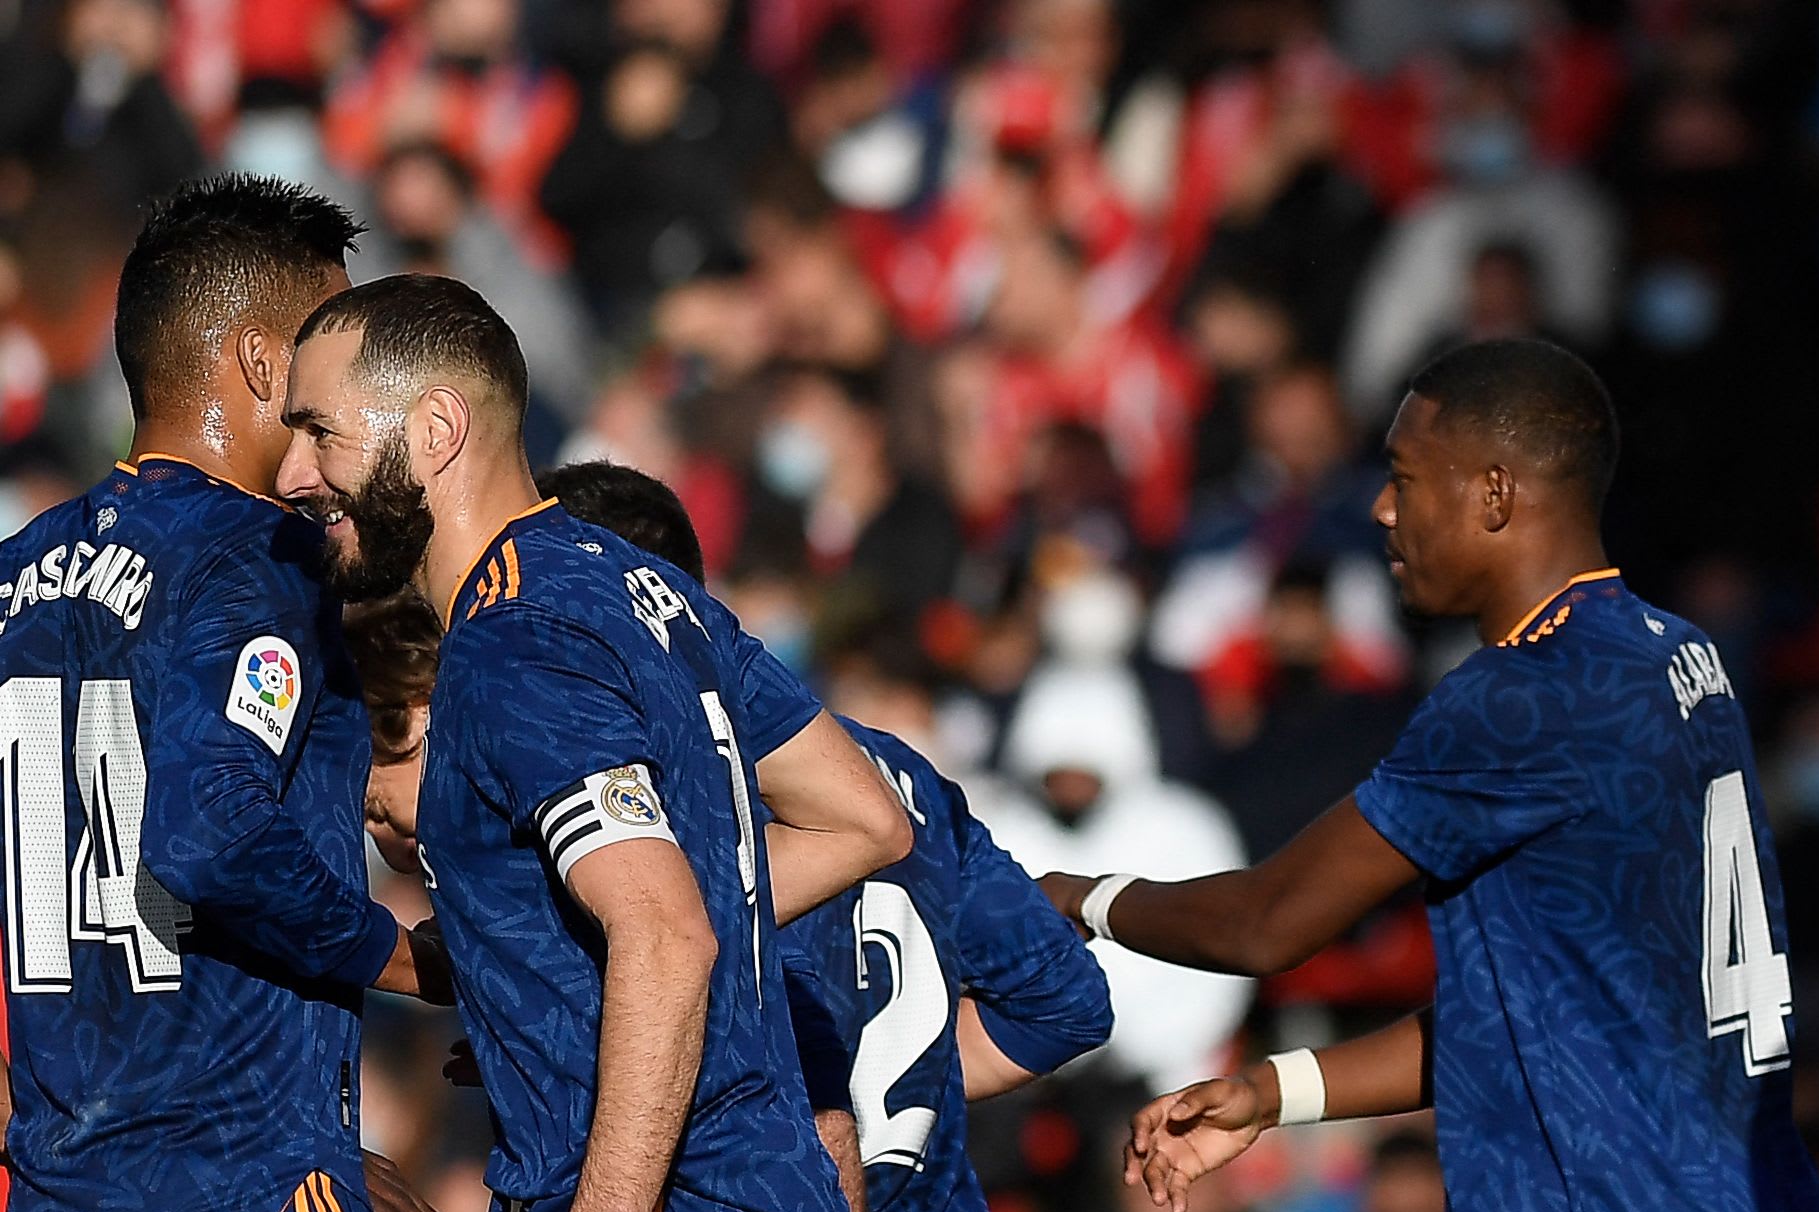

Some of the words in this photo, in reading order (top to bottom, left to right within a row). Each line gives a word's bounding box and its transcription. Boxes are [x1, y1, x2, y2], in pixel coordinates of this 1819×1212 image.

[0, 677, 193, 994] 14
[237, 696, 284, 739] LaLiga
[1701, 770, 1792, 1078] 4
